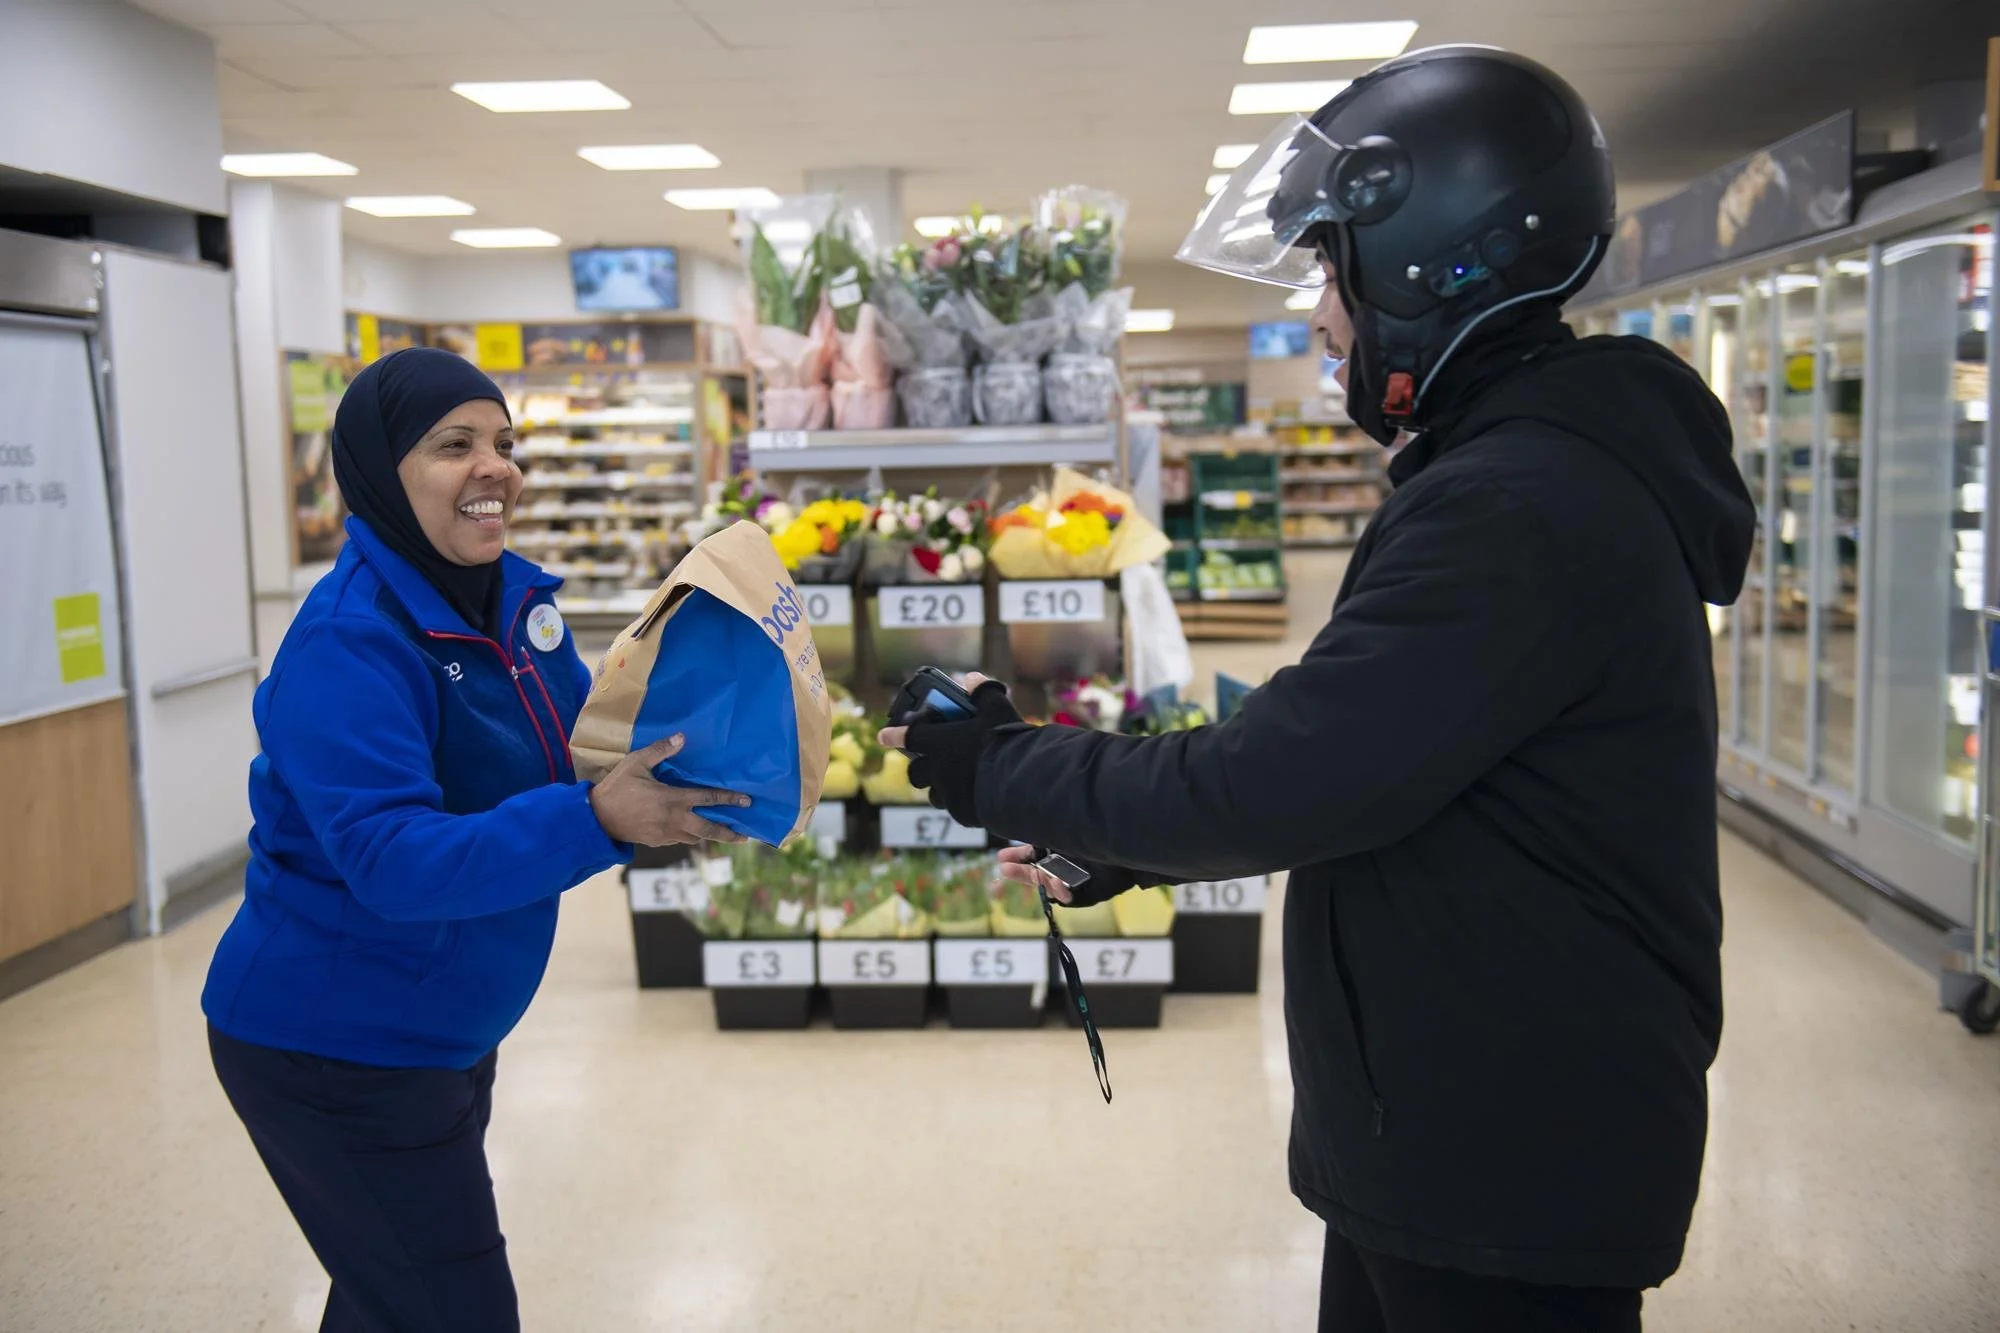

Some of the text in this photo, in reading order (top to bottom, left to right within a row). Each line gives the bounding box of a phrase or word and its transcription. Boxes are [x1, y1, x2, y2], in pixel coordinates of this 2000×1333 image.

[899, 594, 965, 621] £20
[1023, 590, 1082, 616] £10
[916, 816, 950, 844] £7
[1184, 881, 1244, 906] £10
[738, 951, 781, 979] £3
[853, 950, 896, 977] £5
[970, 950, 1014, 977] £5
[1096, 949, 1136, 976] £7
